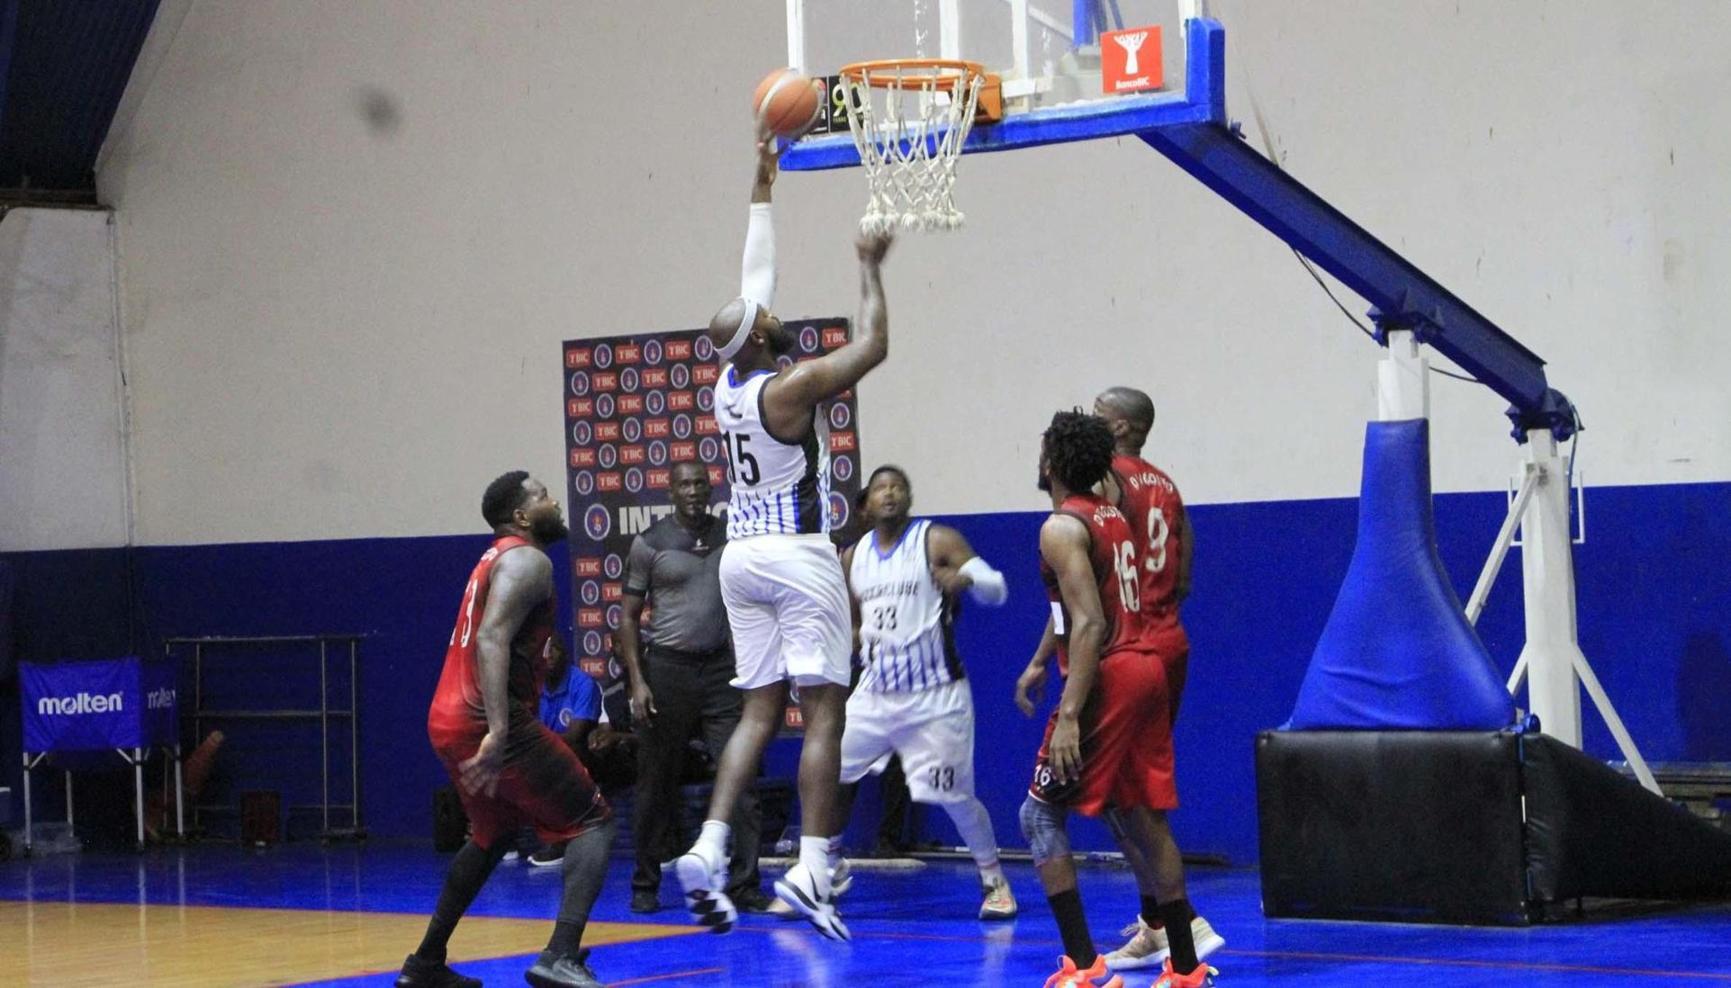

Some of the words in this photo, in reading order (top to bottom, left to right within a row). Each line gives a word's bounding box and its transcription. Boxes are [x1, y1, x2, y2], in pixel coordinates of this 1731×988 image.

[722, 431, 760, 486] 15
[1146, 507, 1169, 573] 9
[1113, 540, 1140, 613] 16
[873, 606, 898, 631] 33
[38, 693, 122, 715] molten
[928, 766, 955, 791] 33
[1034, 763, 1051, 787] 16
